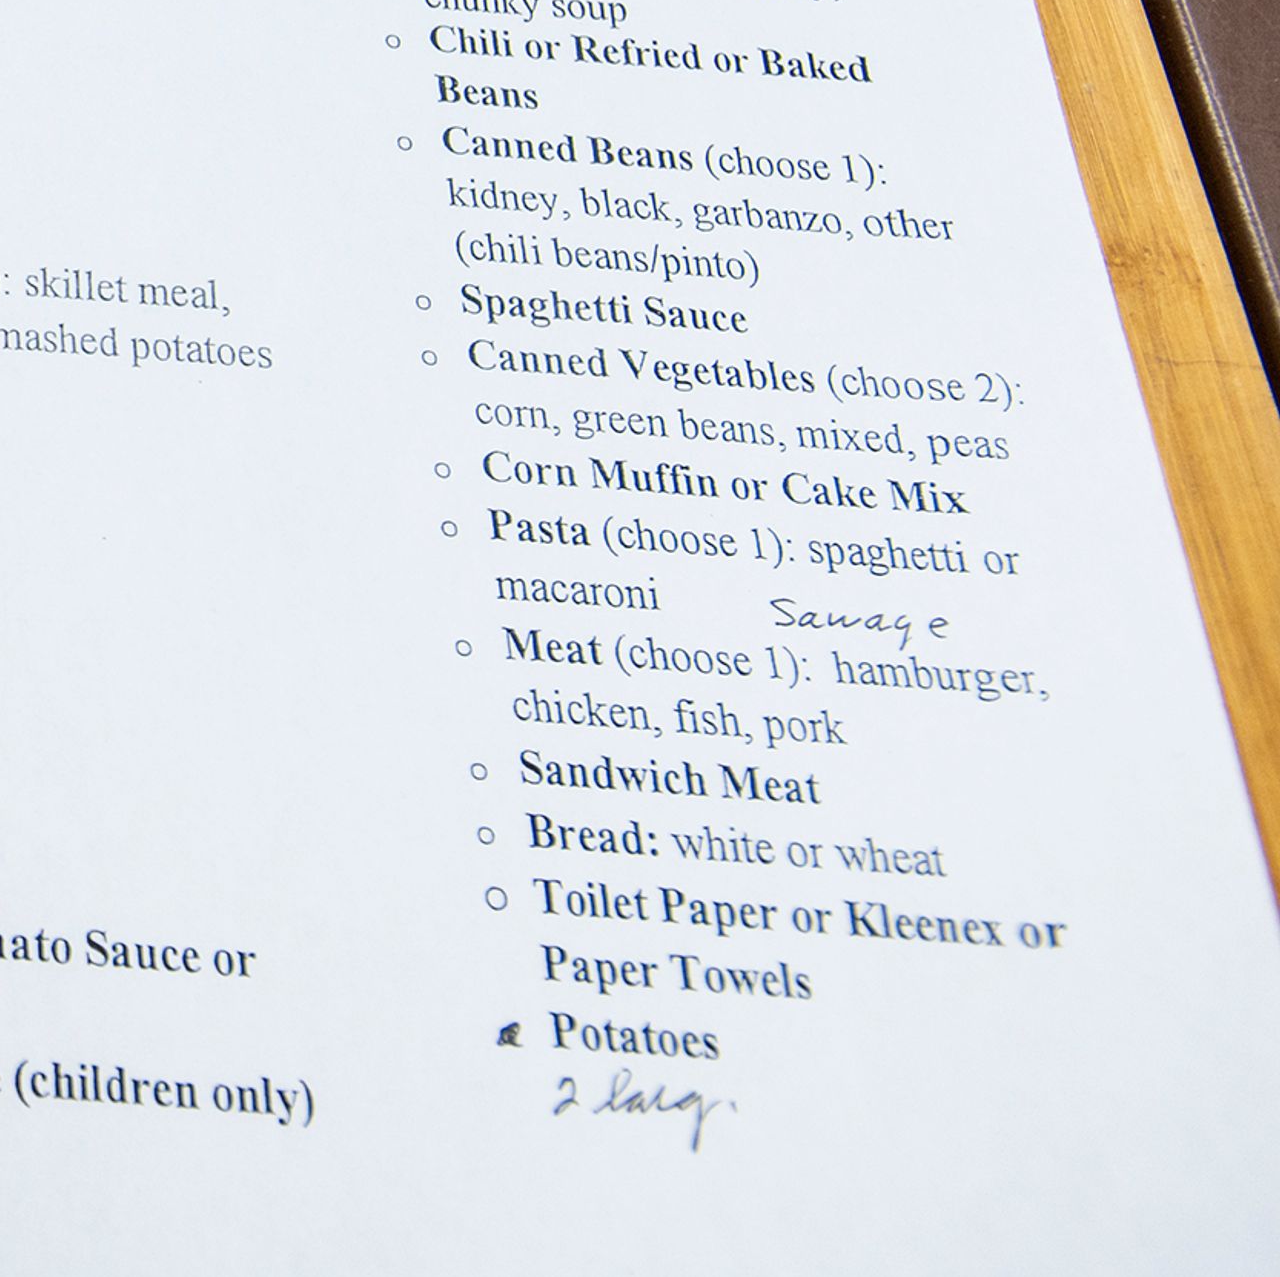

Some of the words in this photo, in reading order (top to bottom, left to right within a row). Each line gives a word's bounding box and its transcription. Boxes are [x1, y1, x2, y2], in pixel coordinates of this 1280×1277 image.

[26, 267, 128, 303] skillet
[138, 280, 230, 317] meal,
[461, 284, 632, 328] Spaghetti
[644, 296, 748, 333] Sauce
[487, 508, 591, 546] Pasta
[603, 516, 737, 557] (choose
[751, 528, 794, 569] 1):
[809, 537, 969, 576] spaghetti
[984, 551, 1019, 574] or
[520, 750, 708, 796] Sandwich
[718, 764, 821, 804] Meat
[549, 1012, 719, 1060] Potatoes
[14, 1060, 199, 1109] (children
[213, 1077, 314, 1127] only)
[553, 1076, 580, 1116] 2
